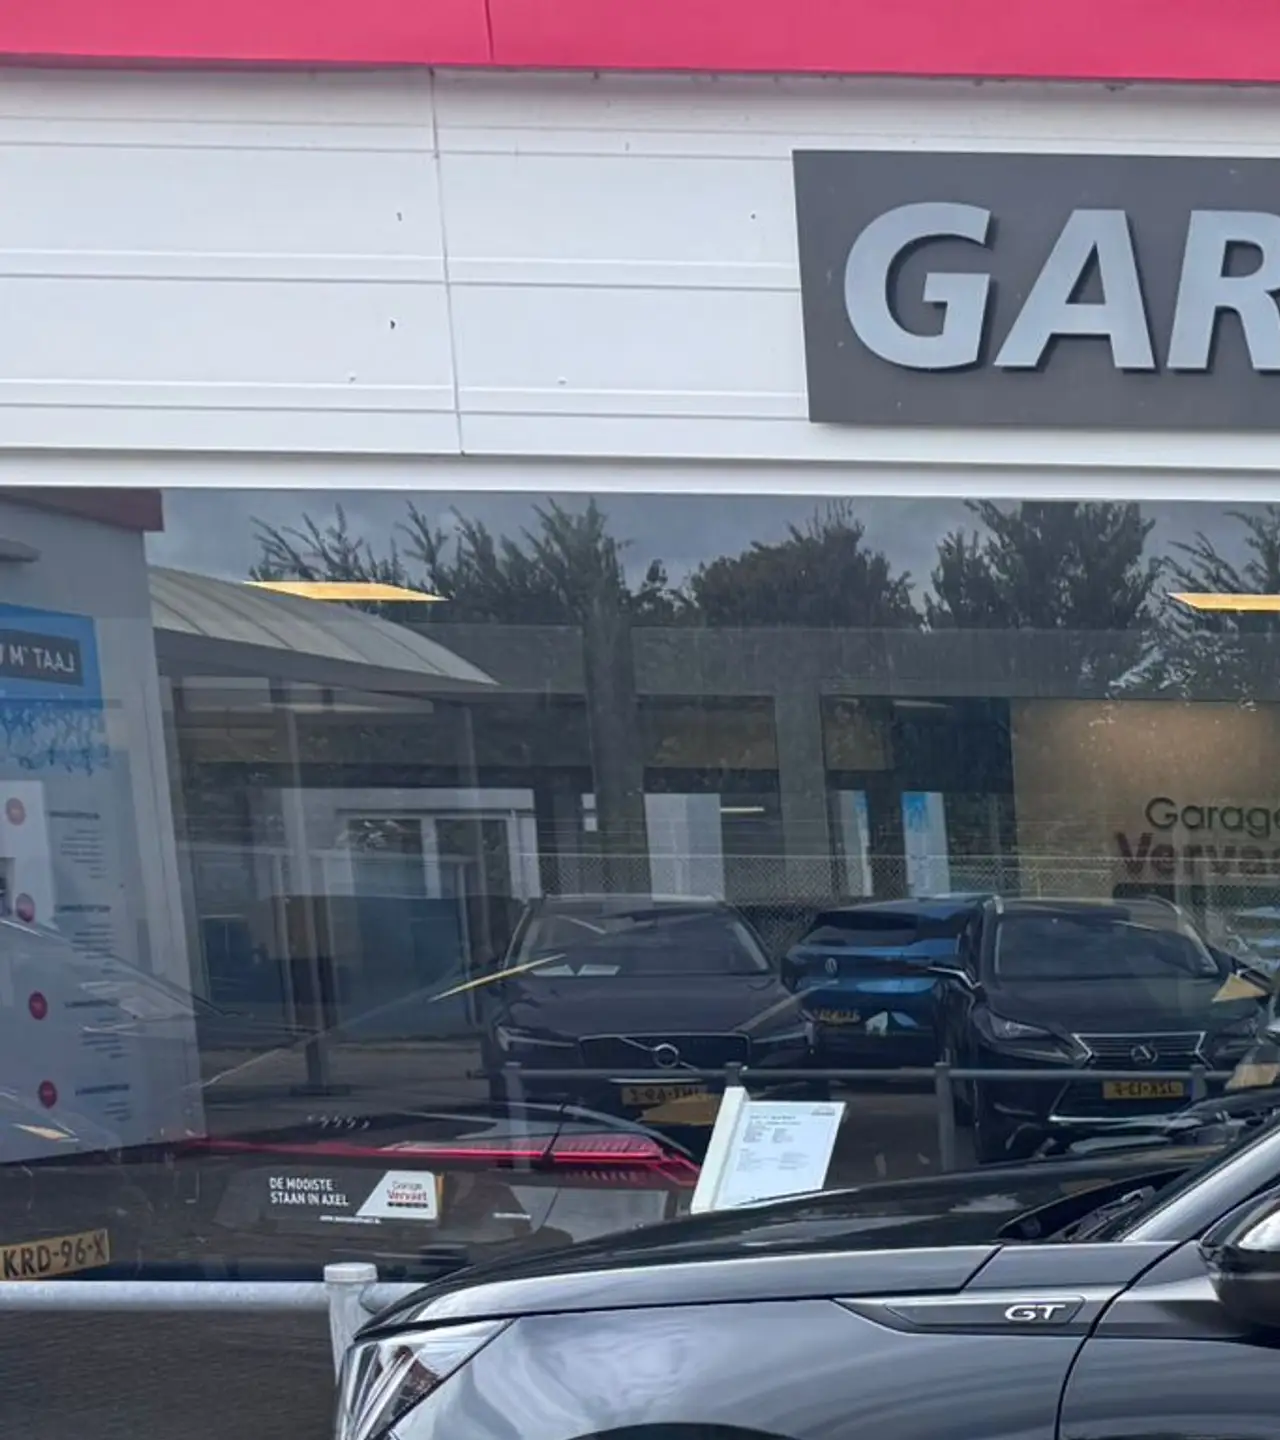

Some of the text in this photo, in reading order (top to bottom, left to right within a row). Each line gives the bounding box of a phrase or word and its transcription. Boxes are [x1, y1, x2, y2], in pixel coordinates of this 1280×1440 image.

[269, 1177, 334, 1192] DE MOOISTE
[270, 1191, 350, 1207] STAAN IN AXEL
[3, 1234, 107, 1279] KRD-96-X
[1004, 1304, 1066, 1321] GT
